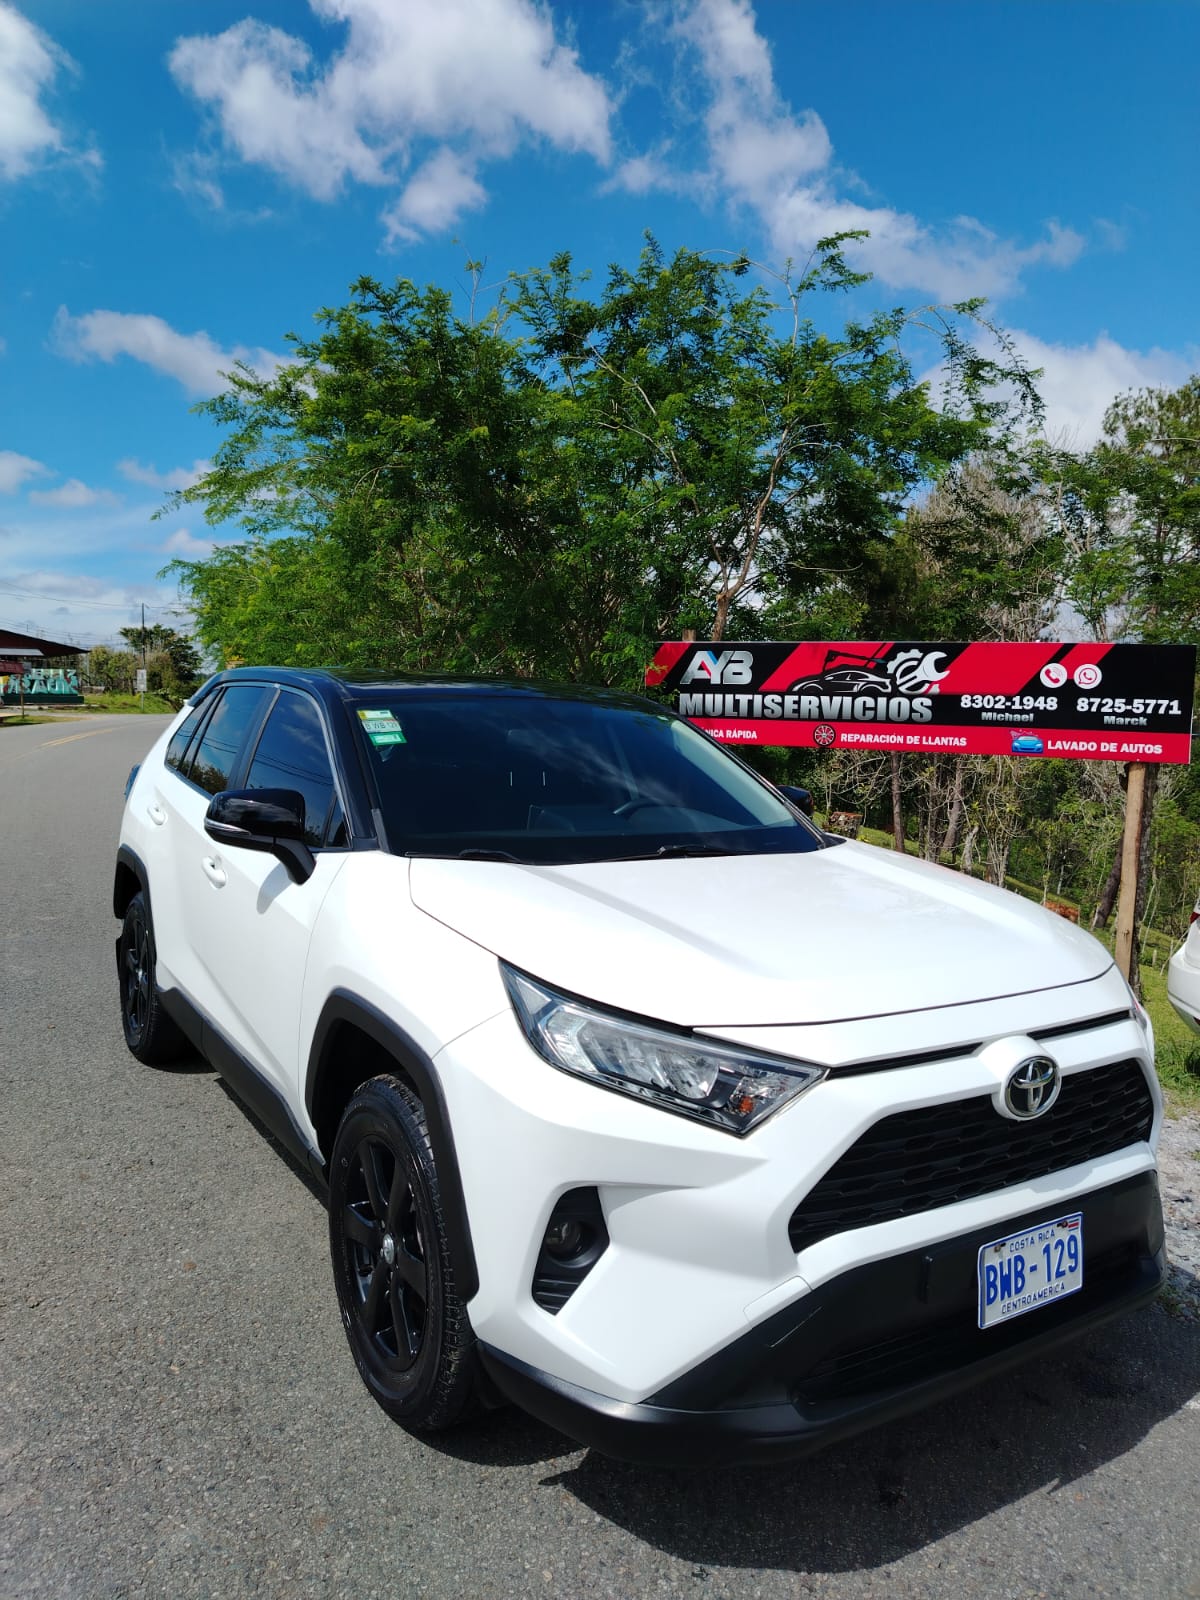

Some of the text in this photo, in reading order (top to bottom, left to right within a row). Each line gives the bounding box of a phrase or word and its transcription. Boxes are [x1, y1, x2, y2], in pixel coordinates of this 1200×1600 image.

[680, 650, 754, 685] AYB
[679, 693, 933, 722] MULTISERVICIOS
[960, 695, 1058, 711] 8302-1948
[1076, 697, 1182, 715] 8725-5771
[981, 711, 1034, 722] Michael
[1103, 715, 1148, 726] Marck
[726, 728, 758, 739] RÁPIDA
[840, 732, 967, 746] REPARACIÓN DE LLANTAS
[1047, 740, 1163, 755] LAVADO DE AUTOS
[1009, 1229, 1055, 1253] COSTA RICA
[985, 1234, 1079, 1306] BWB-129
[1001, 1282, 1065, 1315] CENTROAMERICA
